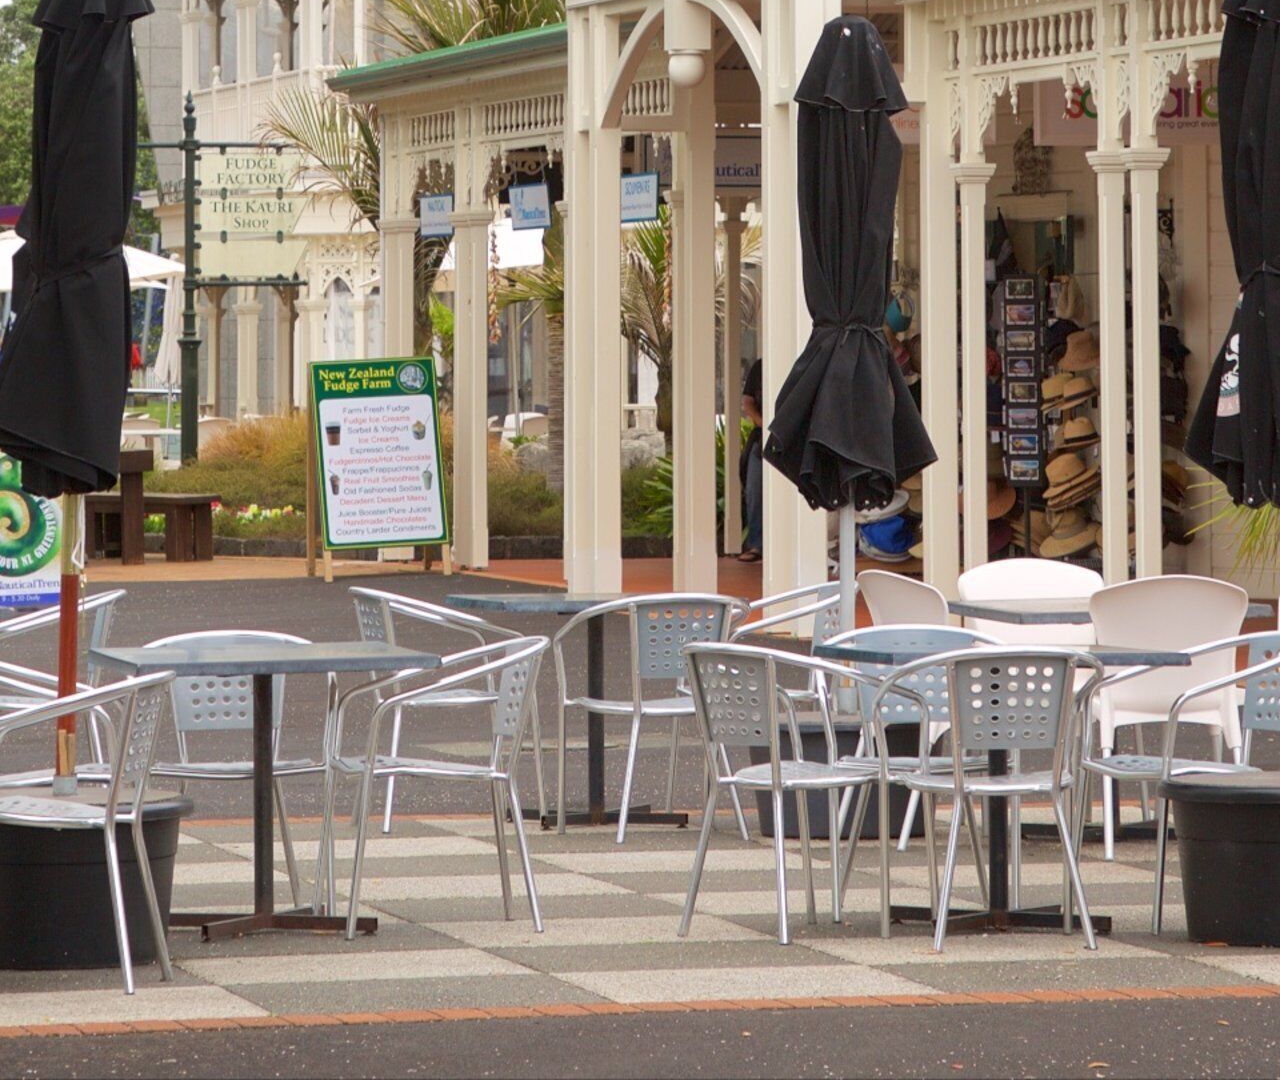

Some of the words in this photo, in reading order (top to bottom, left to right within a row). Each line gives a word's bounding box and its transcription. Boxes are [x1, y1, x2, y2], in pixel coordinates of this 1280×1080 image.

[226, 157, 277, 170] FUDGE
[216, 173, 286, 185] FACTORY
[210, 201, 243, 213] THE
[245, 200, 293, 213] KAURI
[318, 368, 345, 380] New
[349, 366, 395, 380] Zealand
[324, 379, 359, 393] Fudge
[362, 377, 392, 390] Farm
[387, 405, 410, 413] Fudge
[343, 417, 367, 425] Fudge
[381, 415, 410, 423] Creams
[381, 425, 408, 433] Yoghurt
[395, 454, 431, 462] Chocolate
[358, 485, 397, 494] Fashioned
[343, 518, 384, 526] Handmade
[336, 528, 365, 536] Country
[393, 524, 436, 532] Condiments
[21, 554, 34, 567] NZ
